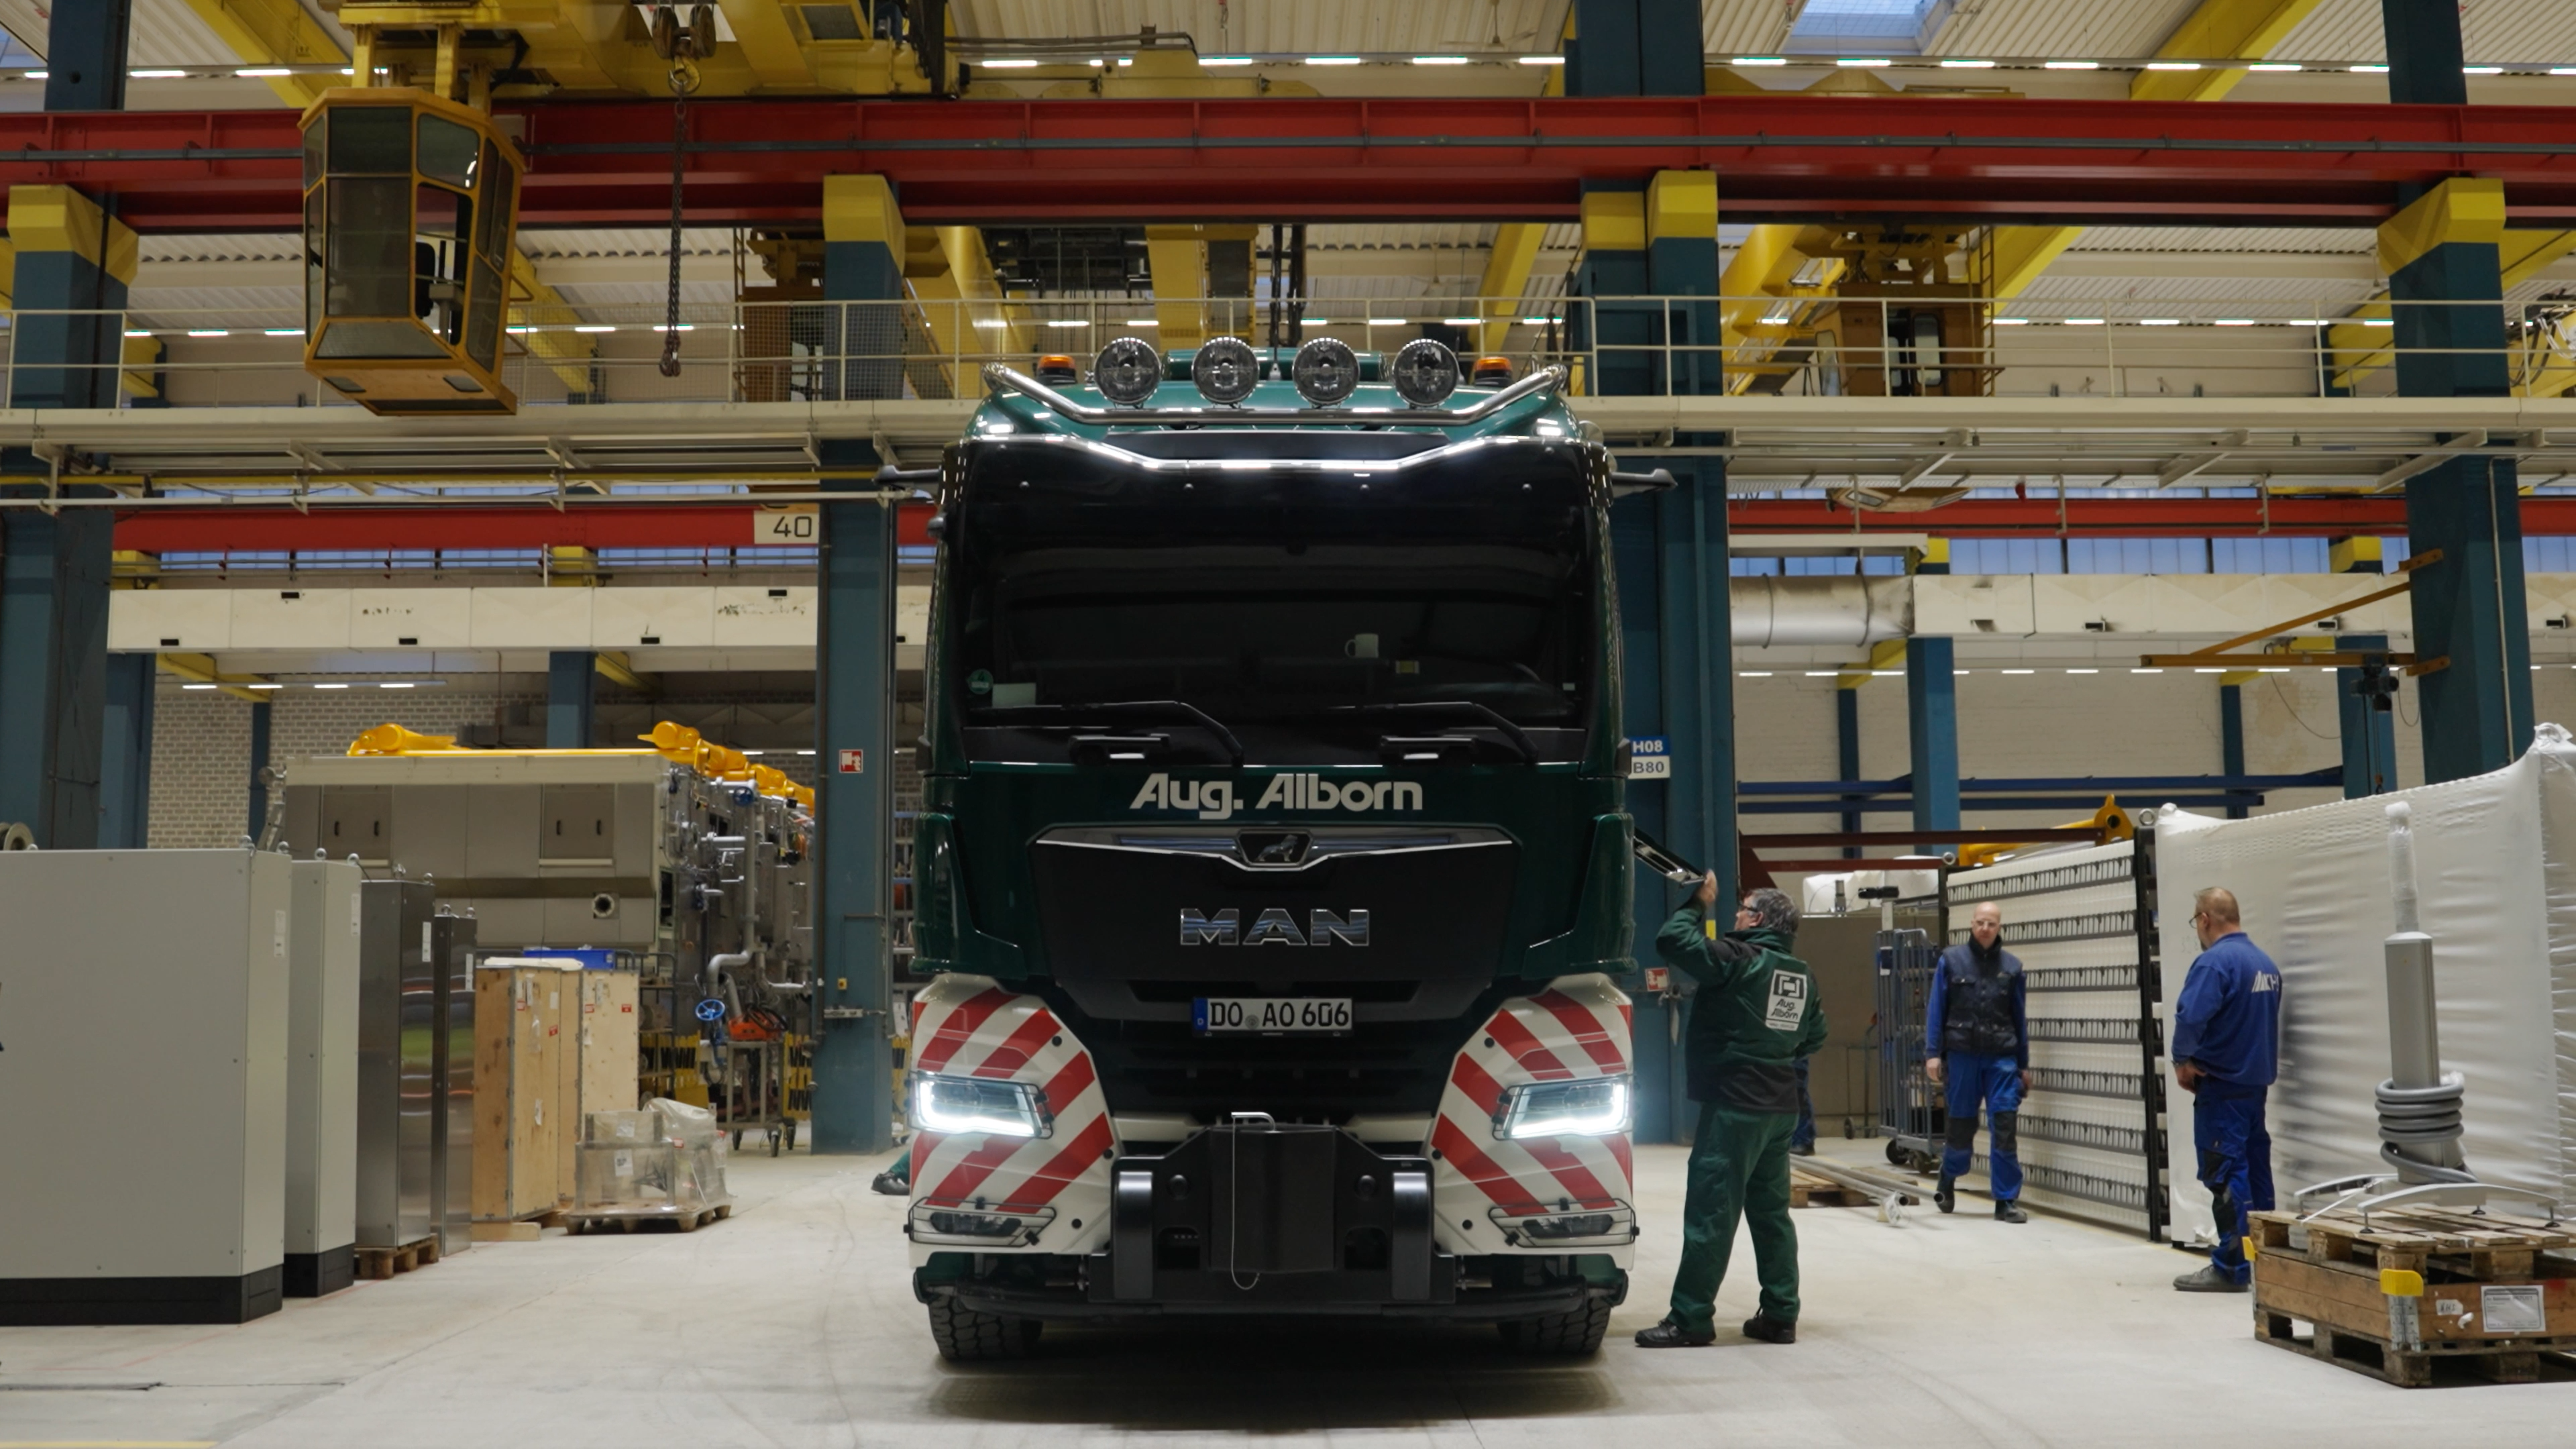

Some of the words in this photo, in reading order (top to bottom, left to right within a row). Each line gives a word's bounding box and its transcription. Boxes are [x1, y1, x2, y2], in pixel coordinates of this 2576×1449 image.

[773, 516, 812, 537] 40
[1633, 740, 1664, 753] H08
[1633, 761, 1664, 773] B80
[1129, 773, 1244, 819] Aug.
[1254, 773, 1423, 812] Alborn
[1181, 908, 1369, 946] MAN
[1197, 1018, 1204, 1026] D
[1210, 1002, 1244, 1027] DO
[1263, 1002, 1295, 1027] AO
[1301, 1002, 1350, 1027] 606
